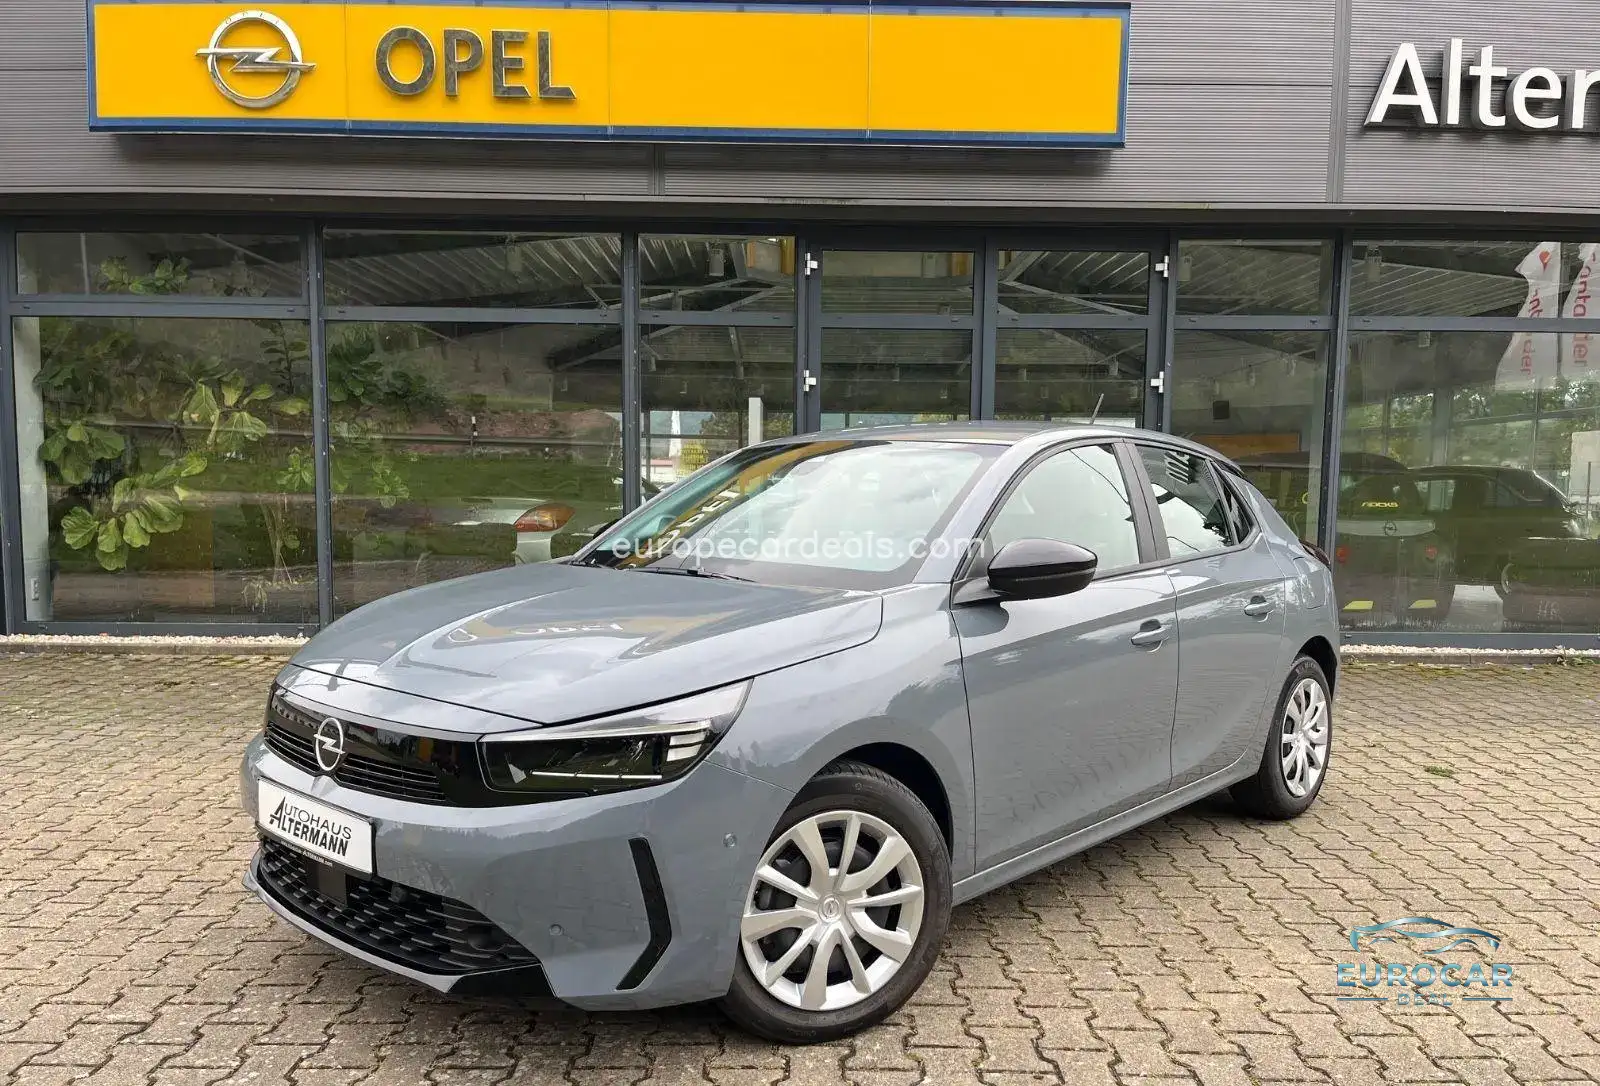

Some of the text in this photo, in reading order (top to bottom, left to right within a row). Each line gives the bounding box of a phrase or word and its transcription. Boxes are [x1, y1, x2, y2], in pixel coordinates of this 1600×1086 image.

[375, 26, 577, 99] OPEL
[1364, 37, 1600, 129] Alter
[269, 808, 349, 857] ALTERMANN
